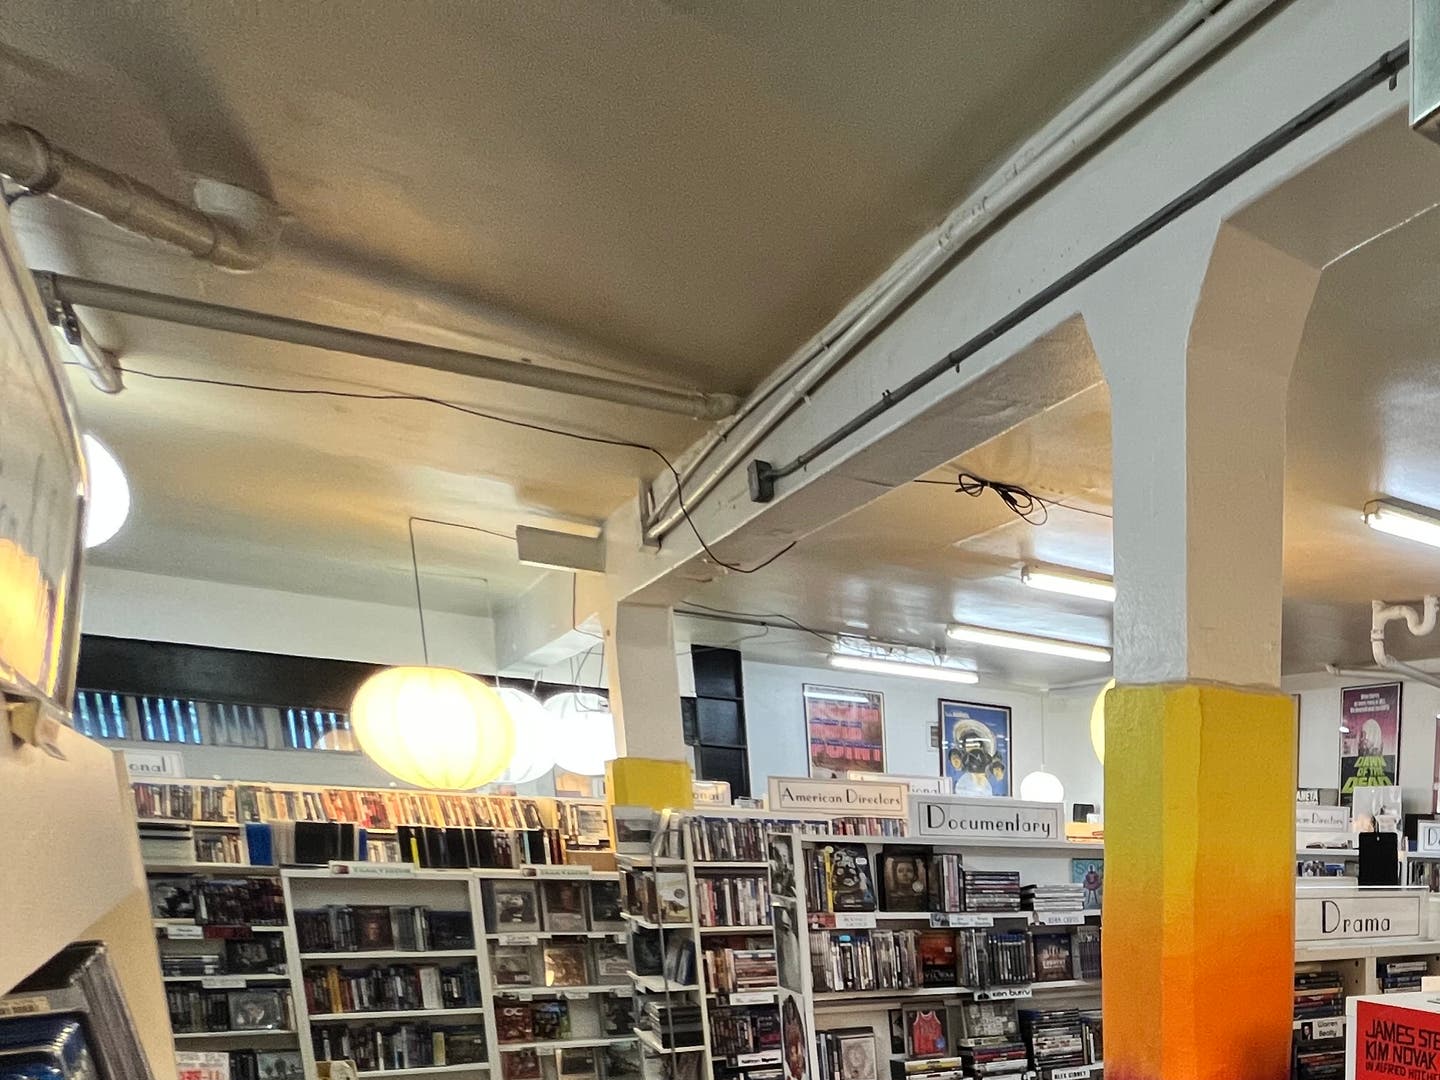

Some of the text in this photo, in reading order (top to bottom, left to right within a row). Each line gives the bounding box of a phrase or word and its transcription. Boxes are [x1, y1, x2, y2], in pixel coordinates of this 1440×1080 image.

[130, 756, 166, 772] onal
[782, 787, 900, 806] American Directors
[927, 804, 1051, 838] Documentary
[1321, 900, 1391, 934] Drama
[1365, 1019, 1415, 1046] JAMES
[1365, 1041, 1437, 1072] KIM NOVAK
[1375, 1062, 1406, 1076] ALFRED
